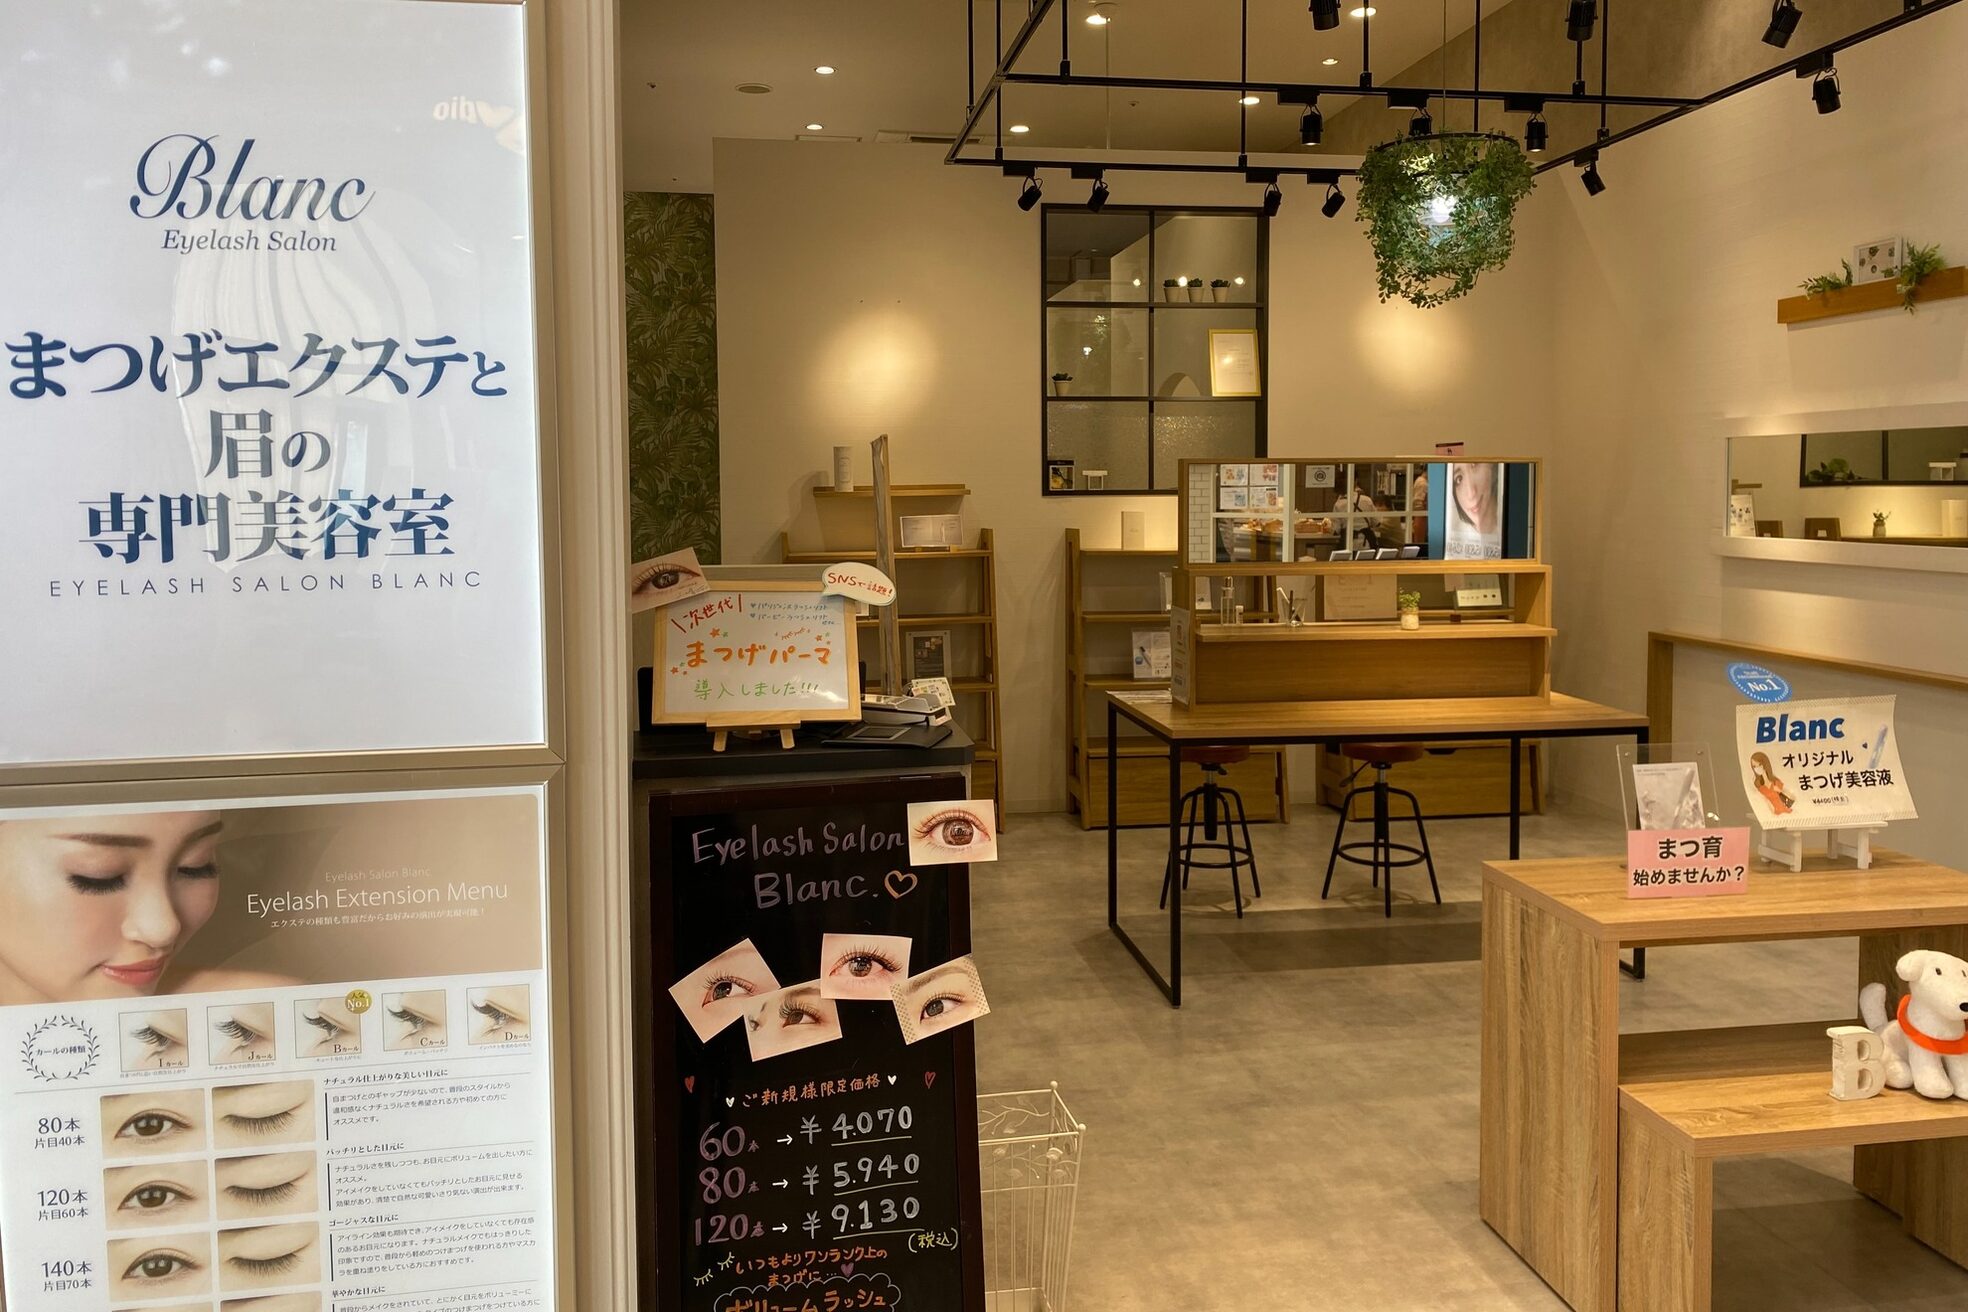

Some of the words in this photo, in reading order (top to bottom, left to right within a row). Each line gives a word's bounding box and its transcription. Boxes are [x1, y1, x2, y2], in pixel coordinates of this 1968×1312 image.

[130, 134, 376, 222] Blanc
[161, 229, 260, 255] Eyelash
[267, 230, 337, 251] Salon
[4, 328, 508, 399] まつげエクステと
[204, 408, 331, 479] 眉の
[78, 488, 456, 564] 専門美容室
[50, 577, 206, 597] EYELASH
[232, 574, 346, 592] SALON
[372, 571, 483, 590] BLANC
[681, 596, 735, 630] 次世代
[686, 641, 832, 668] まつげパーマ
[1755, 713, 1846, 744] Blanc
[1782, 749, 1855, 769] オリジナル
[1798, 768, 1895, 792] まつげ美容液
[692, 823, 813, 866] Eyelash
[823, 822, 905, 855] Salon
[1658, 836, 1724, 860] まつ育
[325, 872, 366, 882] Eyelash
[369, 869, 399, 880] Salon
[401, 867, 432, 878] Blanc
[1633, 865, 1745, 887] 始めませんか？
[247, 890, 329, 919] Eyelash
[336, 885, 440, 908] Extension
[447, 882, 508, 901] Menu
[346, 998, 370, 1010] No.1
[36, 1046, 87, 1057] カールの種類
[742, 1073, 881, 1107] ご新規様限定価格
[38, 1117, 80, 1134] 80本
[34, 1135, 85, 1149] 片目40本
[37, 1189, 88, 1206] 120本
[38, 1207, 88, 1221] 片目60本
[329, 1214, 399, 1227] ゴージャスな目元に
[41, 1260, 92, 1278] 140本
[735, 1246, 888, 1276] いつもよりワンランク上の
[43, 1279, 92, 1292] 片目70本
[332, 1286, 386, 1298] 華やかな目元に
